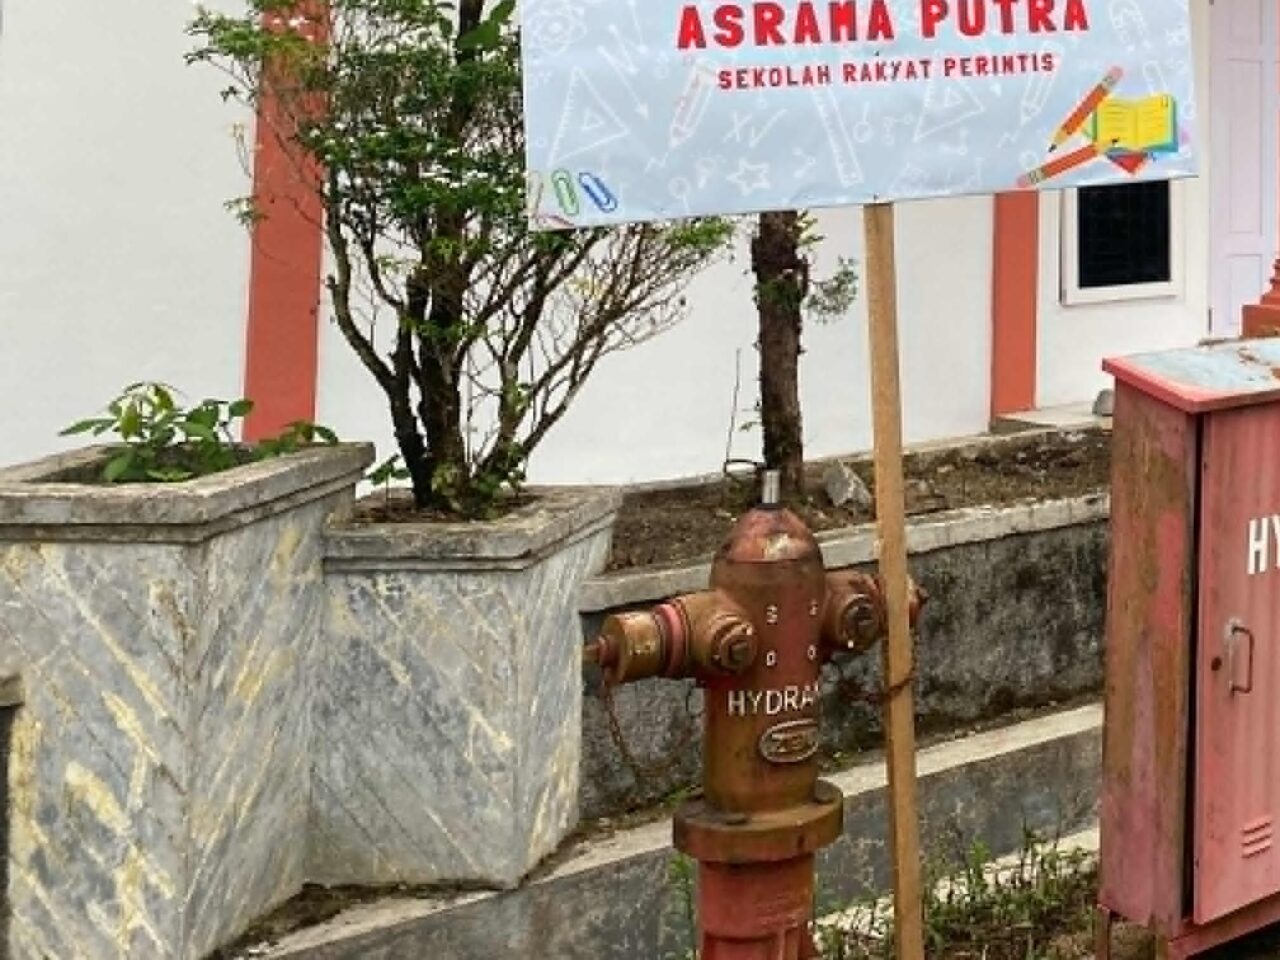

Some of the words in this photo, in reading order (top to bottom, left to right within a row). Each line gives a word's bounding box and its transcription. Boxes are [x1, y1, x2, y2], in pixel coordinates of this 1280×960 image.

[719, 64, 832, 89] SEKOLAH
[842, 59, 932, 83] RAKYAT
[944, 53, 1055, 78] PERINTIS
[728, 682, 819, 717] HYDRA
